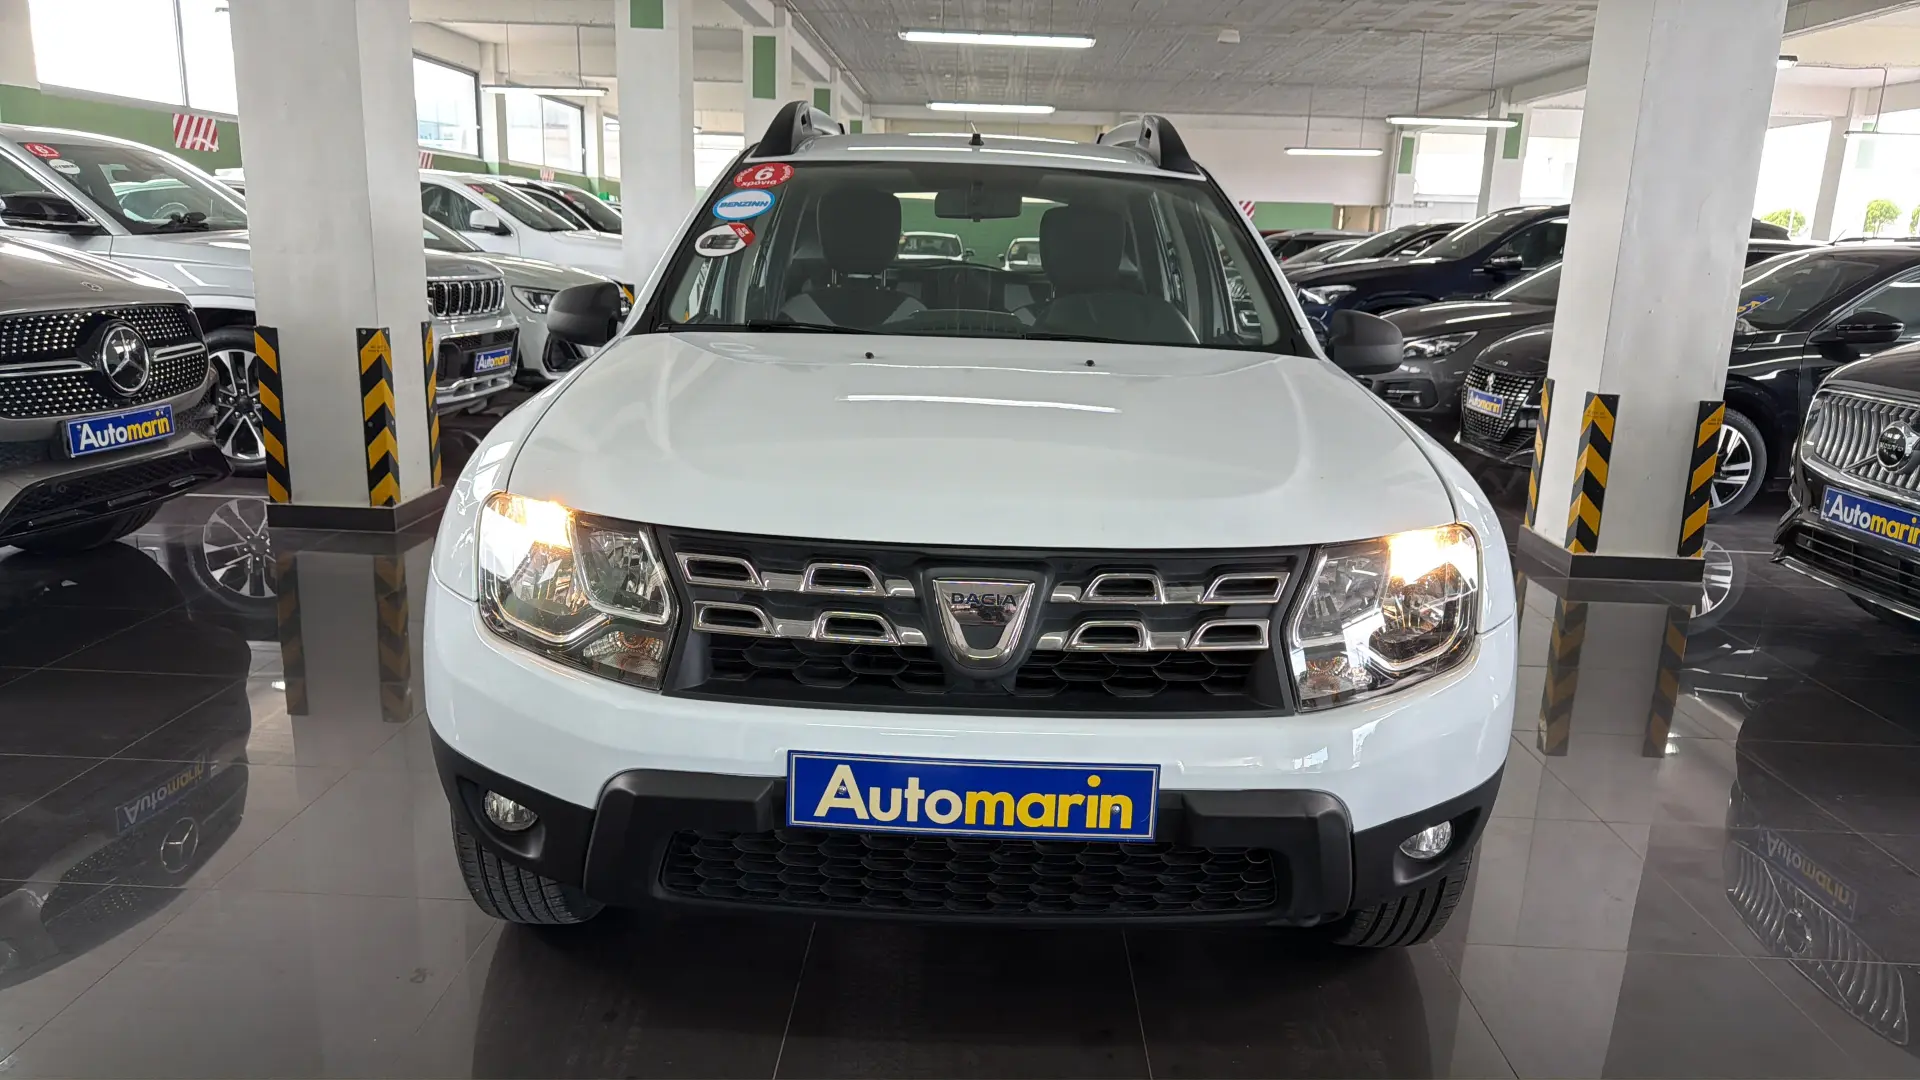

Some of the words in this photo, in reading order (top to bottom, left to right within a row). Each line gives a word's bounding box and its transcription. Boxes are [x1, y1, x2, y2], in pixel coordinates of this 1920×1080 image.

[755, 168, 775, 181] 6
[719, 200, 769, 208] BENZINN
[80, 410, 170, 450] Automarin
[951, 592, 1016, 606] DACIA
[813, 764, 1133, 829] Automarin
